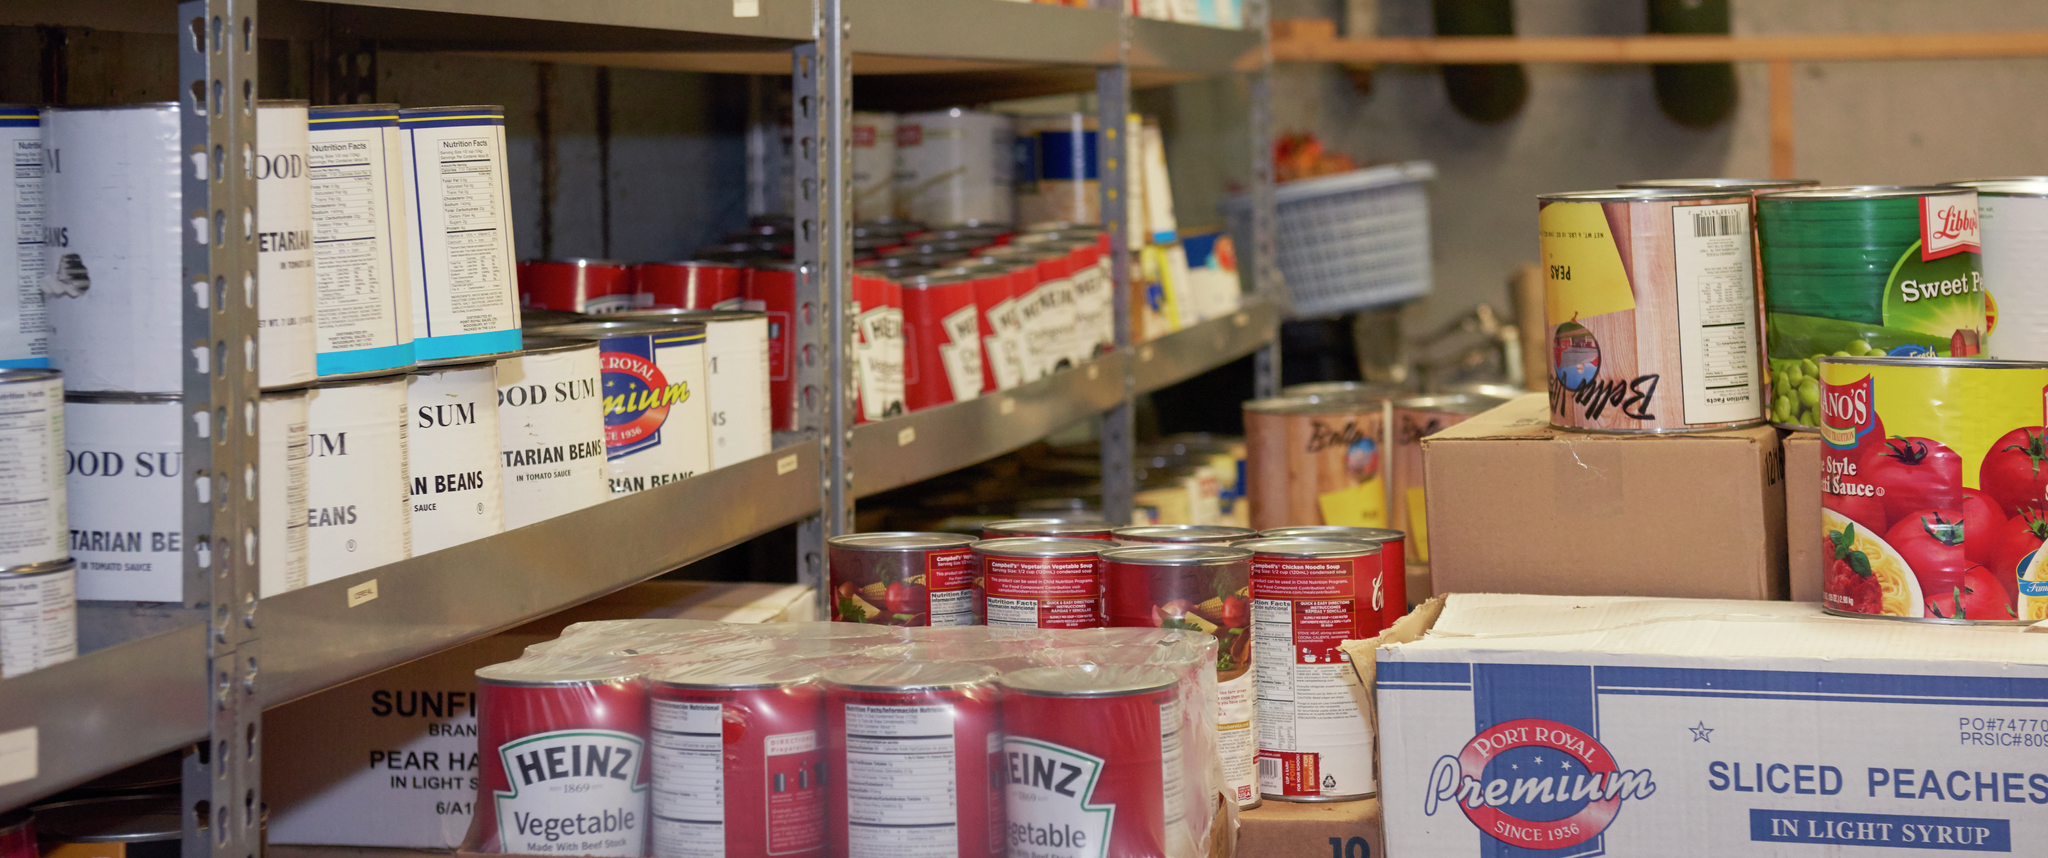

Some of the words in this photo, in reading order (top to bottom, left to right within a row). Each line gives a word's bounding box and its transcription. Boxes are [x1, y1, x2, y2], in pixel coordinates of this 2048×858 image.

[1550, 265, 1571, 280] PEAS
[1901, 273, 1969, 303] Sweet
[609, 357, 654, 381] ROYAL
[555, 378, 595, 403] SUM
[1573, 374, 1660, 420] Bella
[418, 402, 476, 428] SUM
[621, 426, 642, 440] 1936
[569, 439, 601, 461] BEANS
[526, 472, 552, 481] TOMATO
[554, 470, 571, 478] SAUCE
[1826, 456, 1857, 482] Style
[435, 470, 484, 494] BEANS
[1833, 476, 1874, 497] Sauce
[414, 503, 437, 512] SAUCE
[90, 562, 122, 571] TOMATO
[124, 563, 152, 572] SAUCE
[1472, 727, 1529, 759] PORT
[1535, 727, 1596, 763] ROYAL
[370, 751, 439, 771] PEAR
[516, 744, 632, 786] HEINZ
[391, 775, 406, 789] IN
[413, 776, 463, 790] LIGHT
[563, 783, 590, 794] 1869
[1425, 755, 1656, 816] Premium
[1708, 760, 1843, 796] SLICED
[1868, 767, 2048, 804] PEACHES
[514, 807, 636, 842] Vegetable
[1494, 820, 1543, 841] SINCE
[1548, 823, 1580, 841] 1936
[1771, 818, 1799, 837] IN
[1808, 820, 1892, 841] LIGHT
[1902, 824, 1990, 846] SYRUP
[527, 842, 553, 852] Made
[555, 842, 578, 851] With
[581, 840, 603, 850] Beef
[604, 837, 626, 849] Stock
